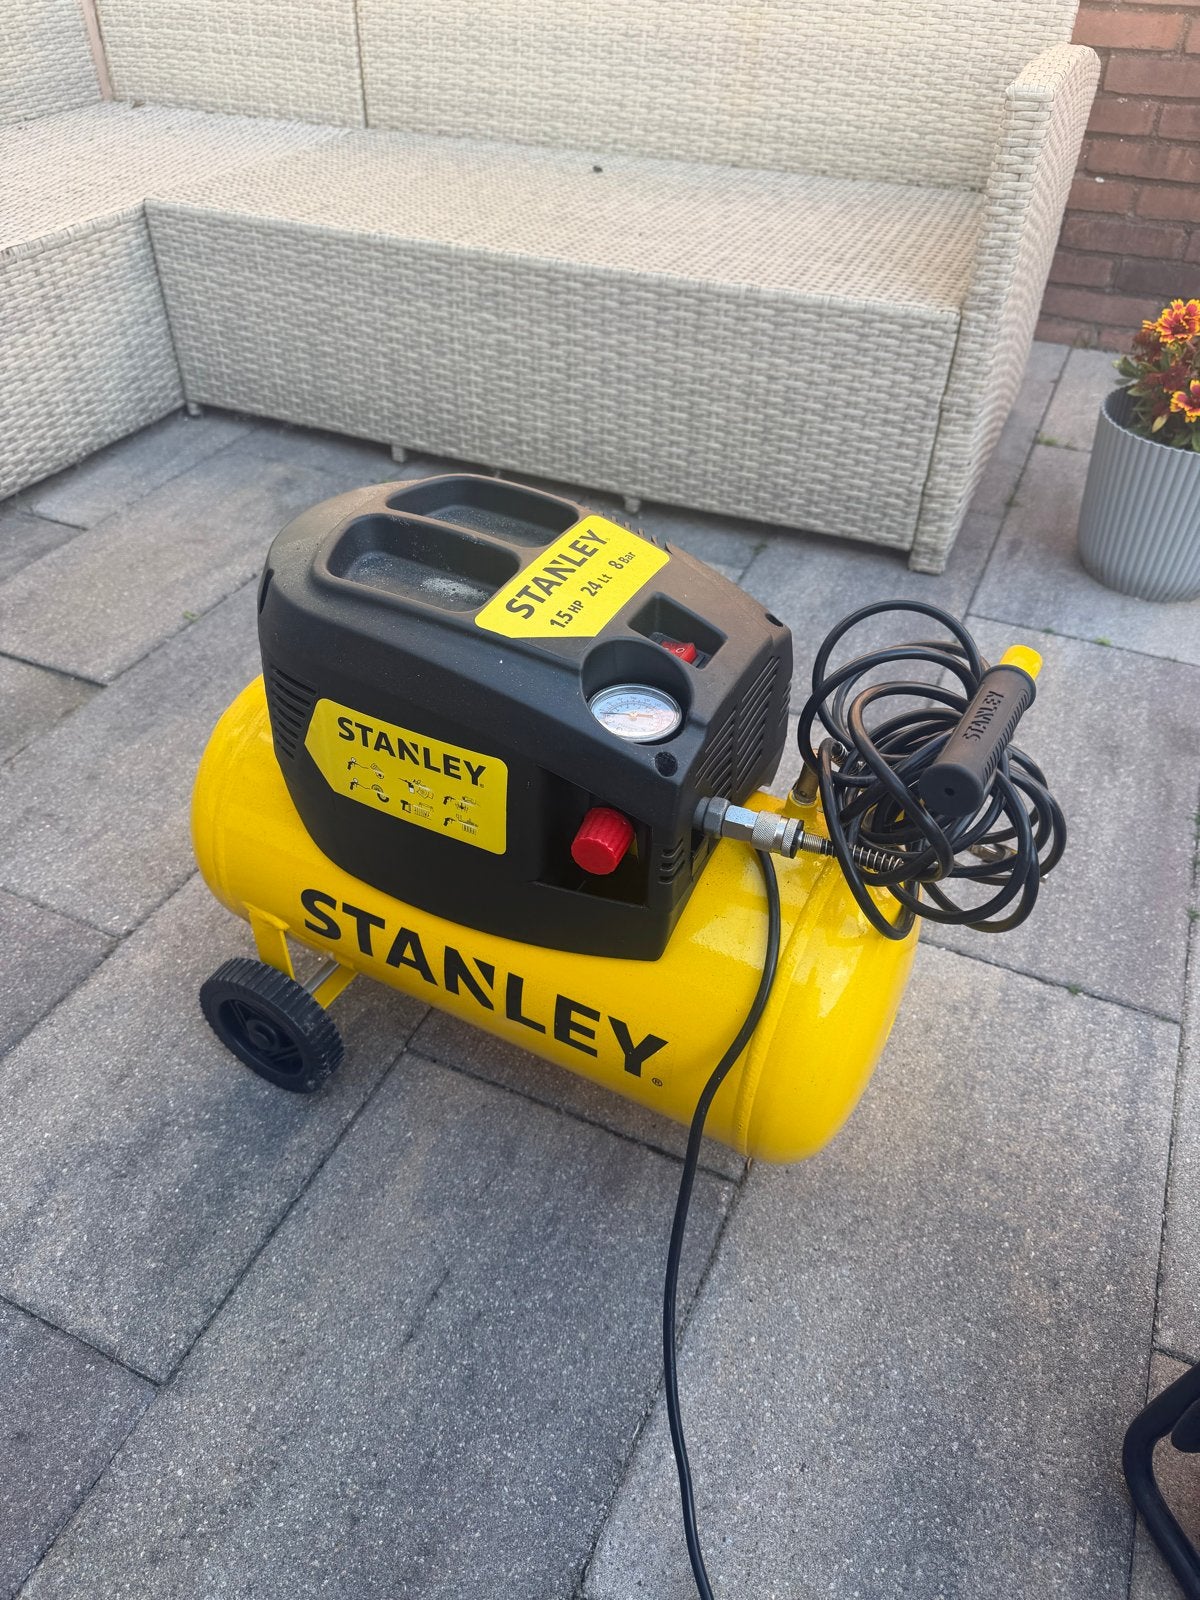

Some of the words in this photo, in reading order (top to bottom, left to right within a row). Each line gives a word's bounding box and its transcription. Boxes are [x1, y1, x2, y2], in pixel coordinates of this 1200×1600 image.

[505, 529, 608, 620] STANLEY
[550, 610, 574, 628] 1.5
[568, 600, 584, 614] HP
[580, 580, 603, 597] 24
[599, 573, 613, 584] Lt
[608, 559, 624, 570] 8
[620, 551, 636, 566] Bar
[337, 716, 486, 786] STANLEY
[962, 690, 1004, 741] STANLEY
[300, 888, 669, 1078] STANLEY
